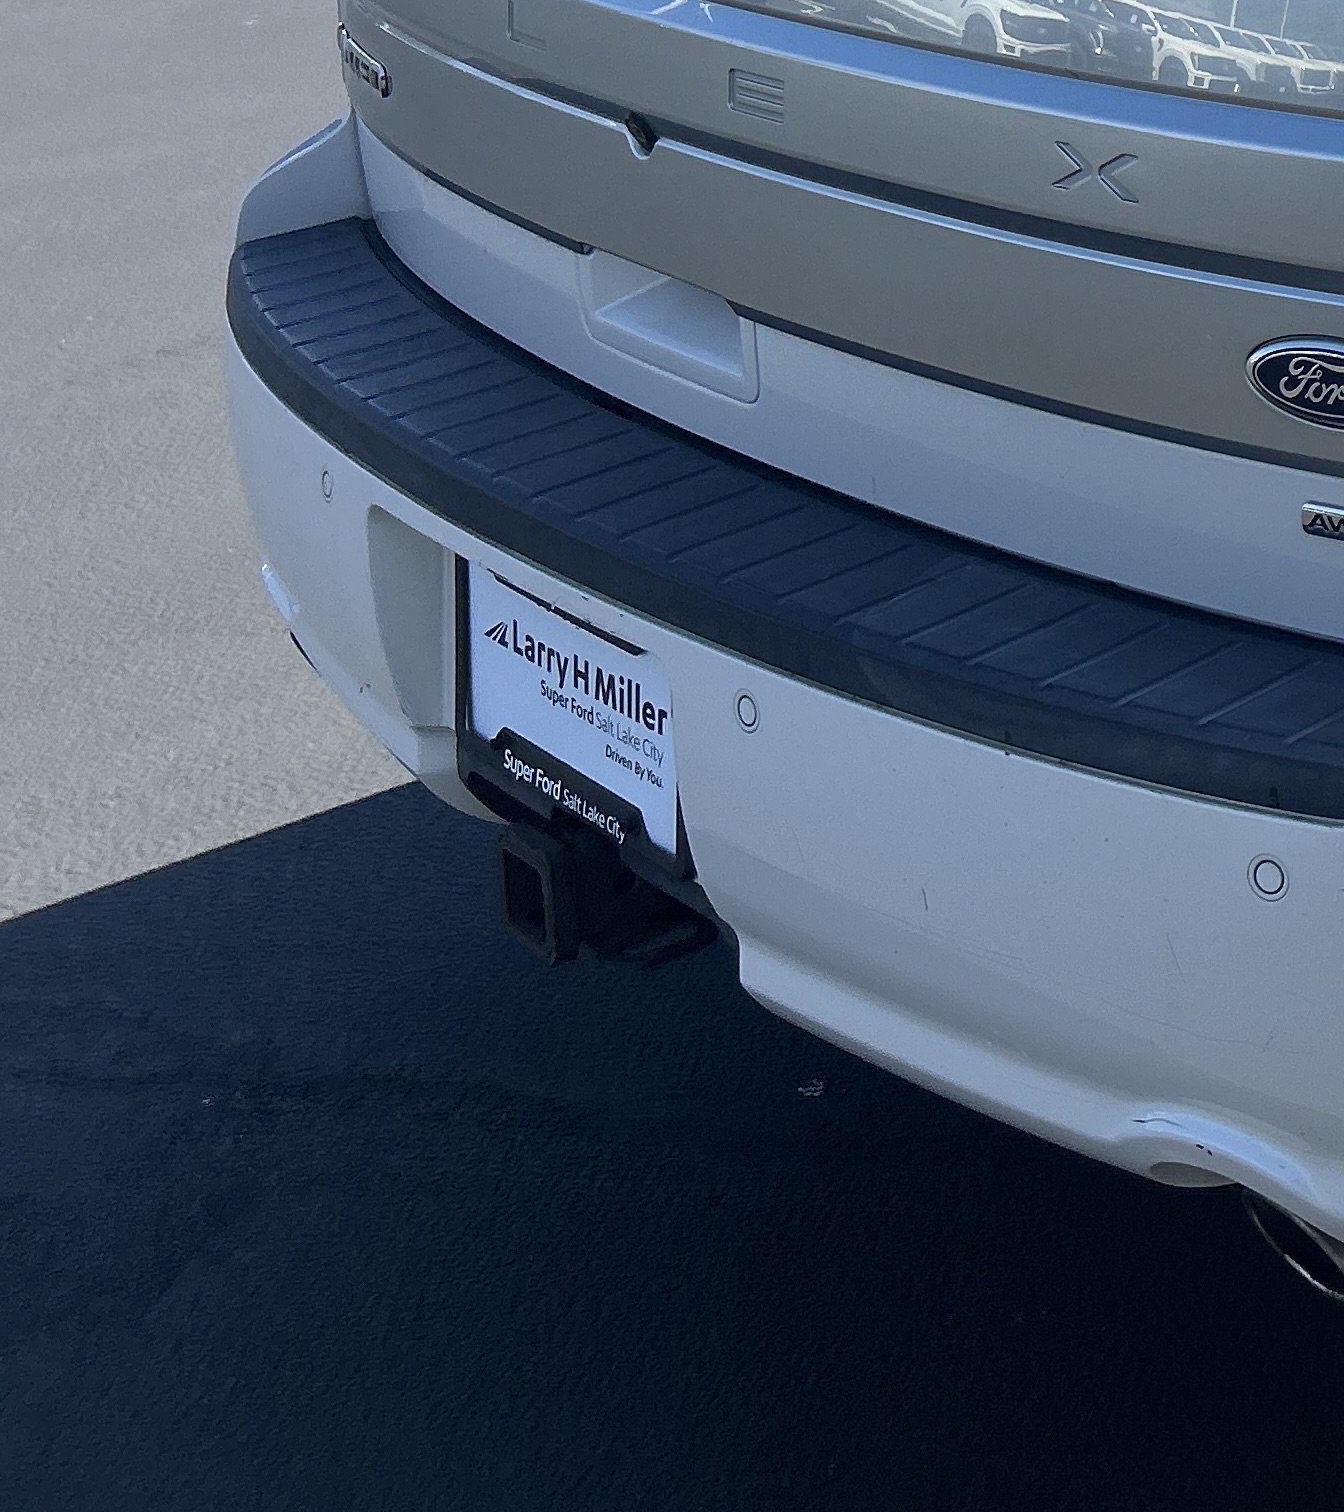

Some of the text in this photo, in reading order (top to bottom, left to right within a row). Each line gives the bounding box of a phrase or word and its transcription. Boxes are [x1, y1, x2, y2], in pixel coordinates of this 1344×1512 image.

[513, 619, 668, 735] Larry H Miller
[540, 679, 664, 768] Super Ford Salt Lake City
[605, 744, 664, 788] Driven By You.
[503, 748, 625, 844] Super Ford Salt Lake City
